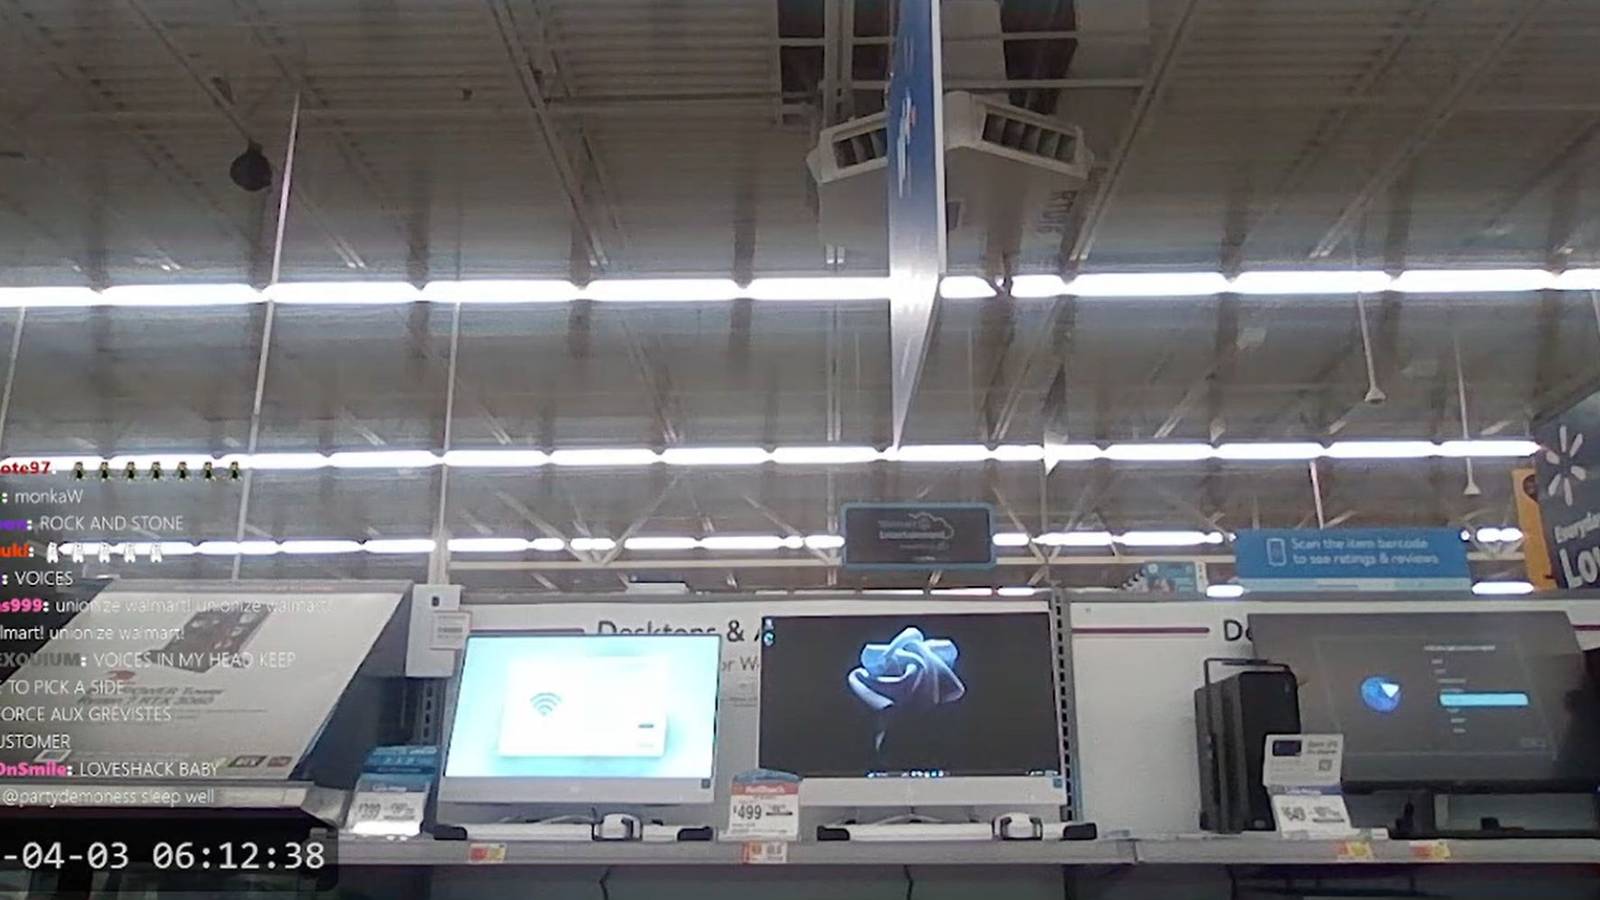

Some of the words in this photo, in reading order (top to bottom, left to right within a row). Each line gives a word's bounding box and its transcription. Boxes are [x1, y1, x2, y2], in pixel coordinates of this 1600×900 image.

[1292, 538, 1320, 549] Scan
[1323, 538, 1344, 549] the
[1346, 538, 1375, 549] item
[1378, 538, 1429, 549] barcode
[1293, 554, 1306, 564] to
[1310, 555, 1331, 564] see
[1334, 554, 1377, 567] ratings
[1379, 552, 1389, 564] &
[1391, 554, 1440, 564] reviews
[726, 620, 744, 642] &
